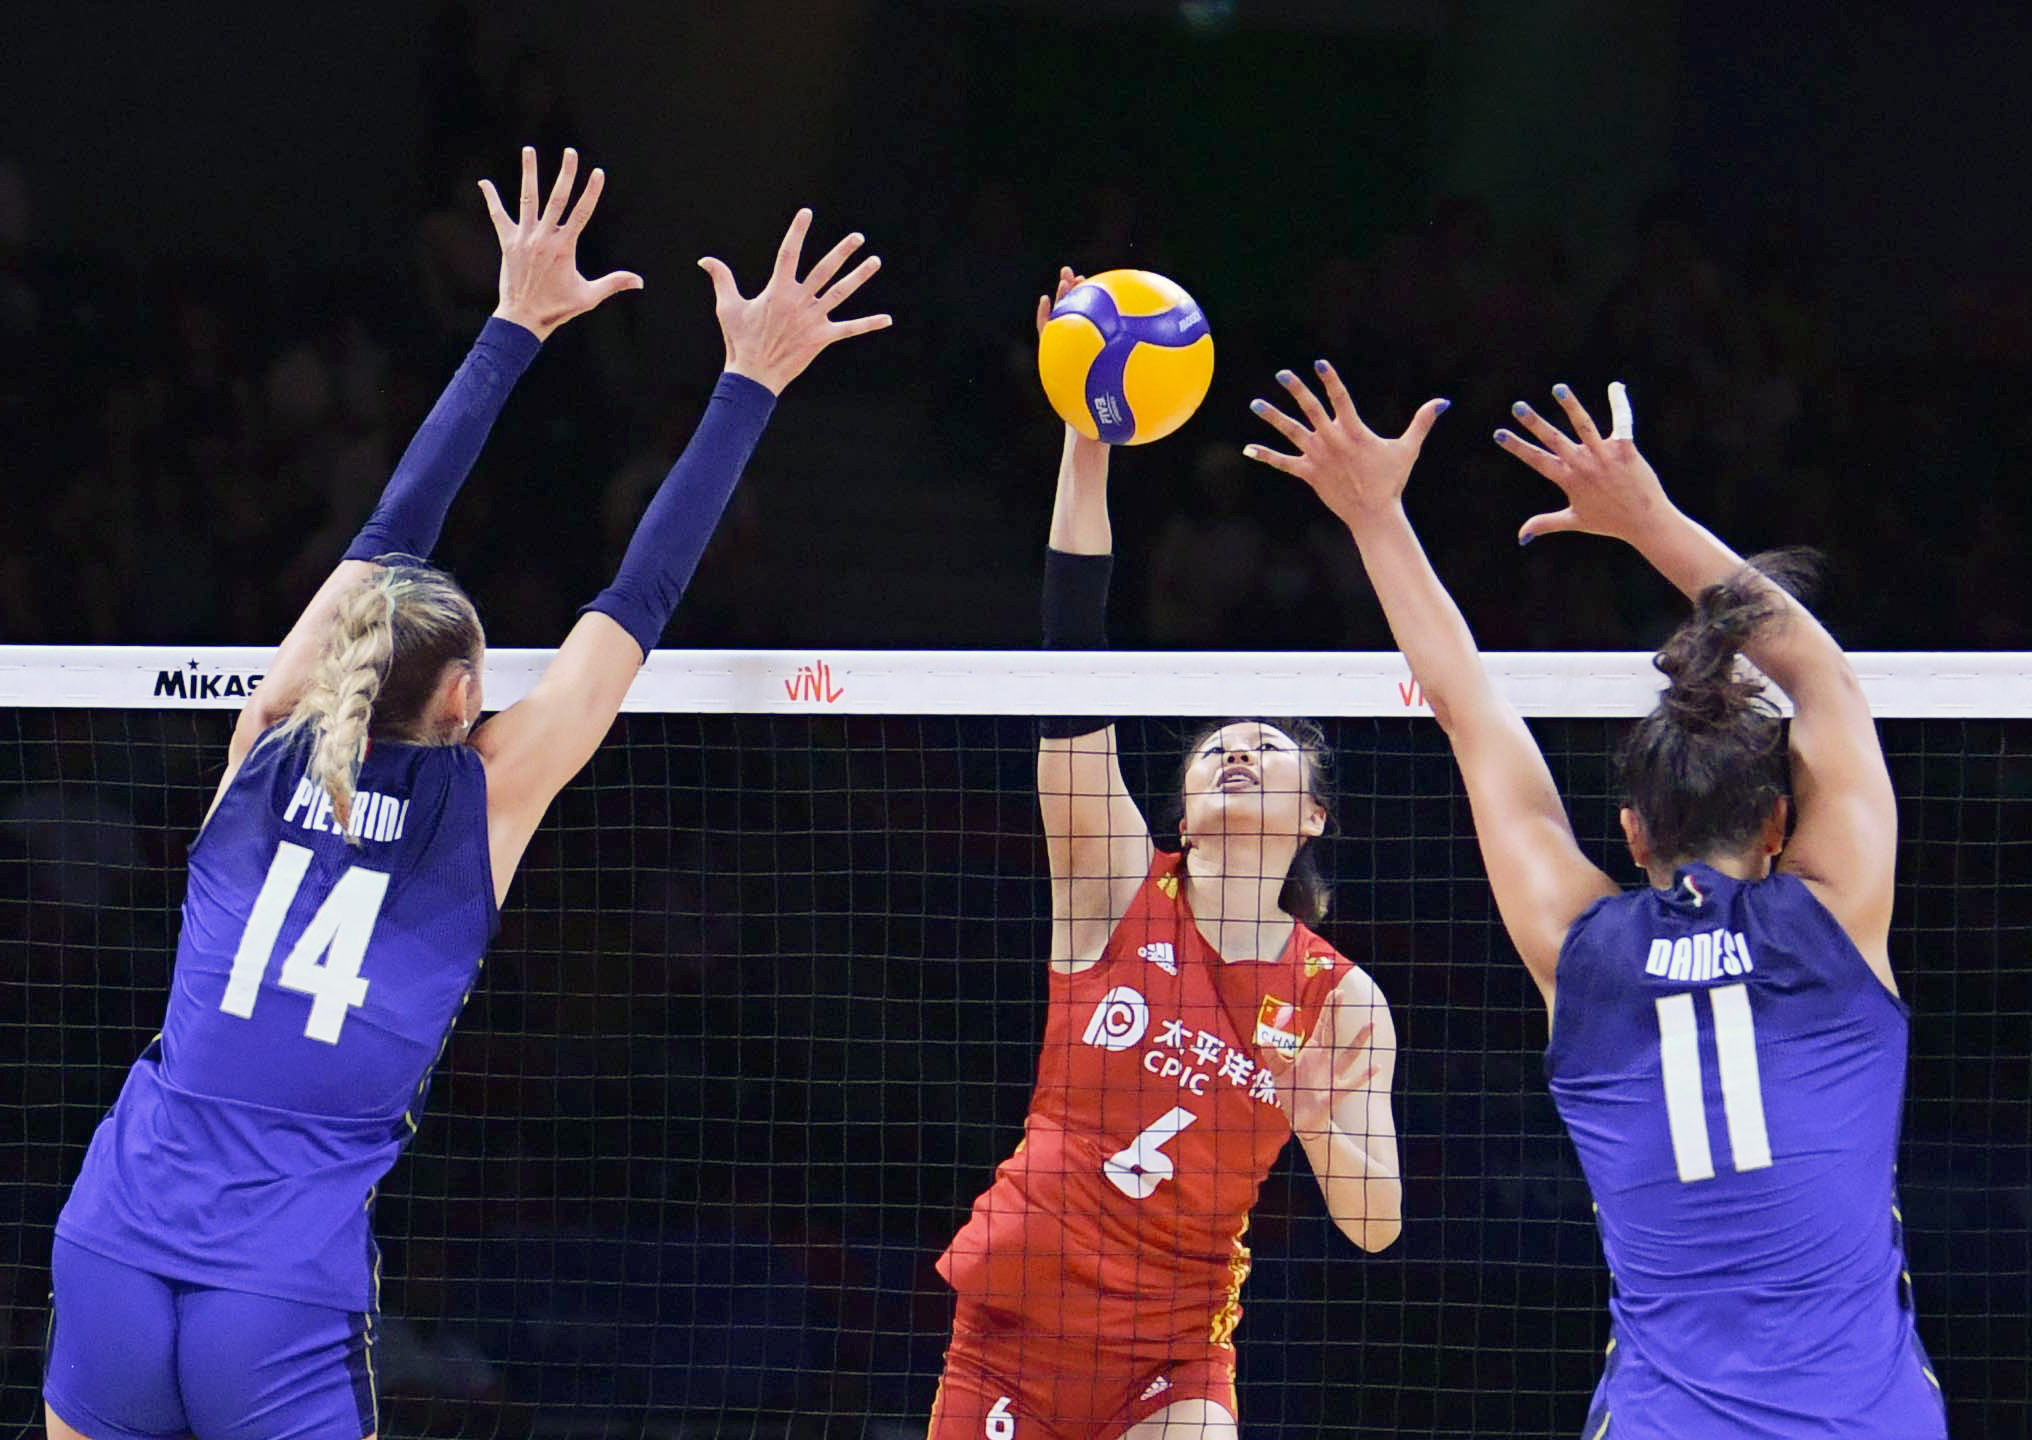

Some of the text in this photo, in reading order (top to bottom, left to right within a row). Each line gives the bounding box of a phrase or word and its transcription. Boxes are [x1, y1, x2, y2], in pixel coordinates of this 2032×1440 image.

[283, 775, 410, 842] PIERINI
[219, 839, 391, 1045] 14
[1645, 928, 1754, 981] DANESI
[1143, 1050, 1211, 1096] CPIC
[1655, 983, 1773, 1183] 11
[1103, 1105, 1197, 1200] 6
[985, 1396, 1016, 1440] 6
